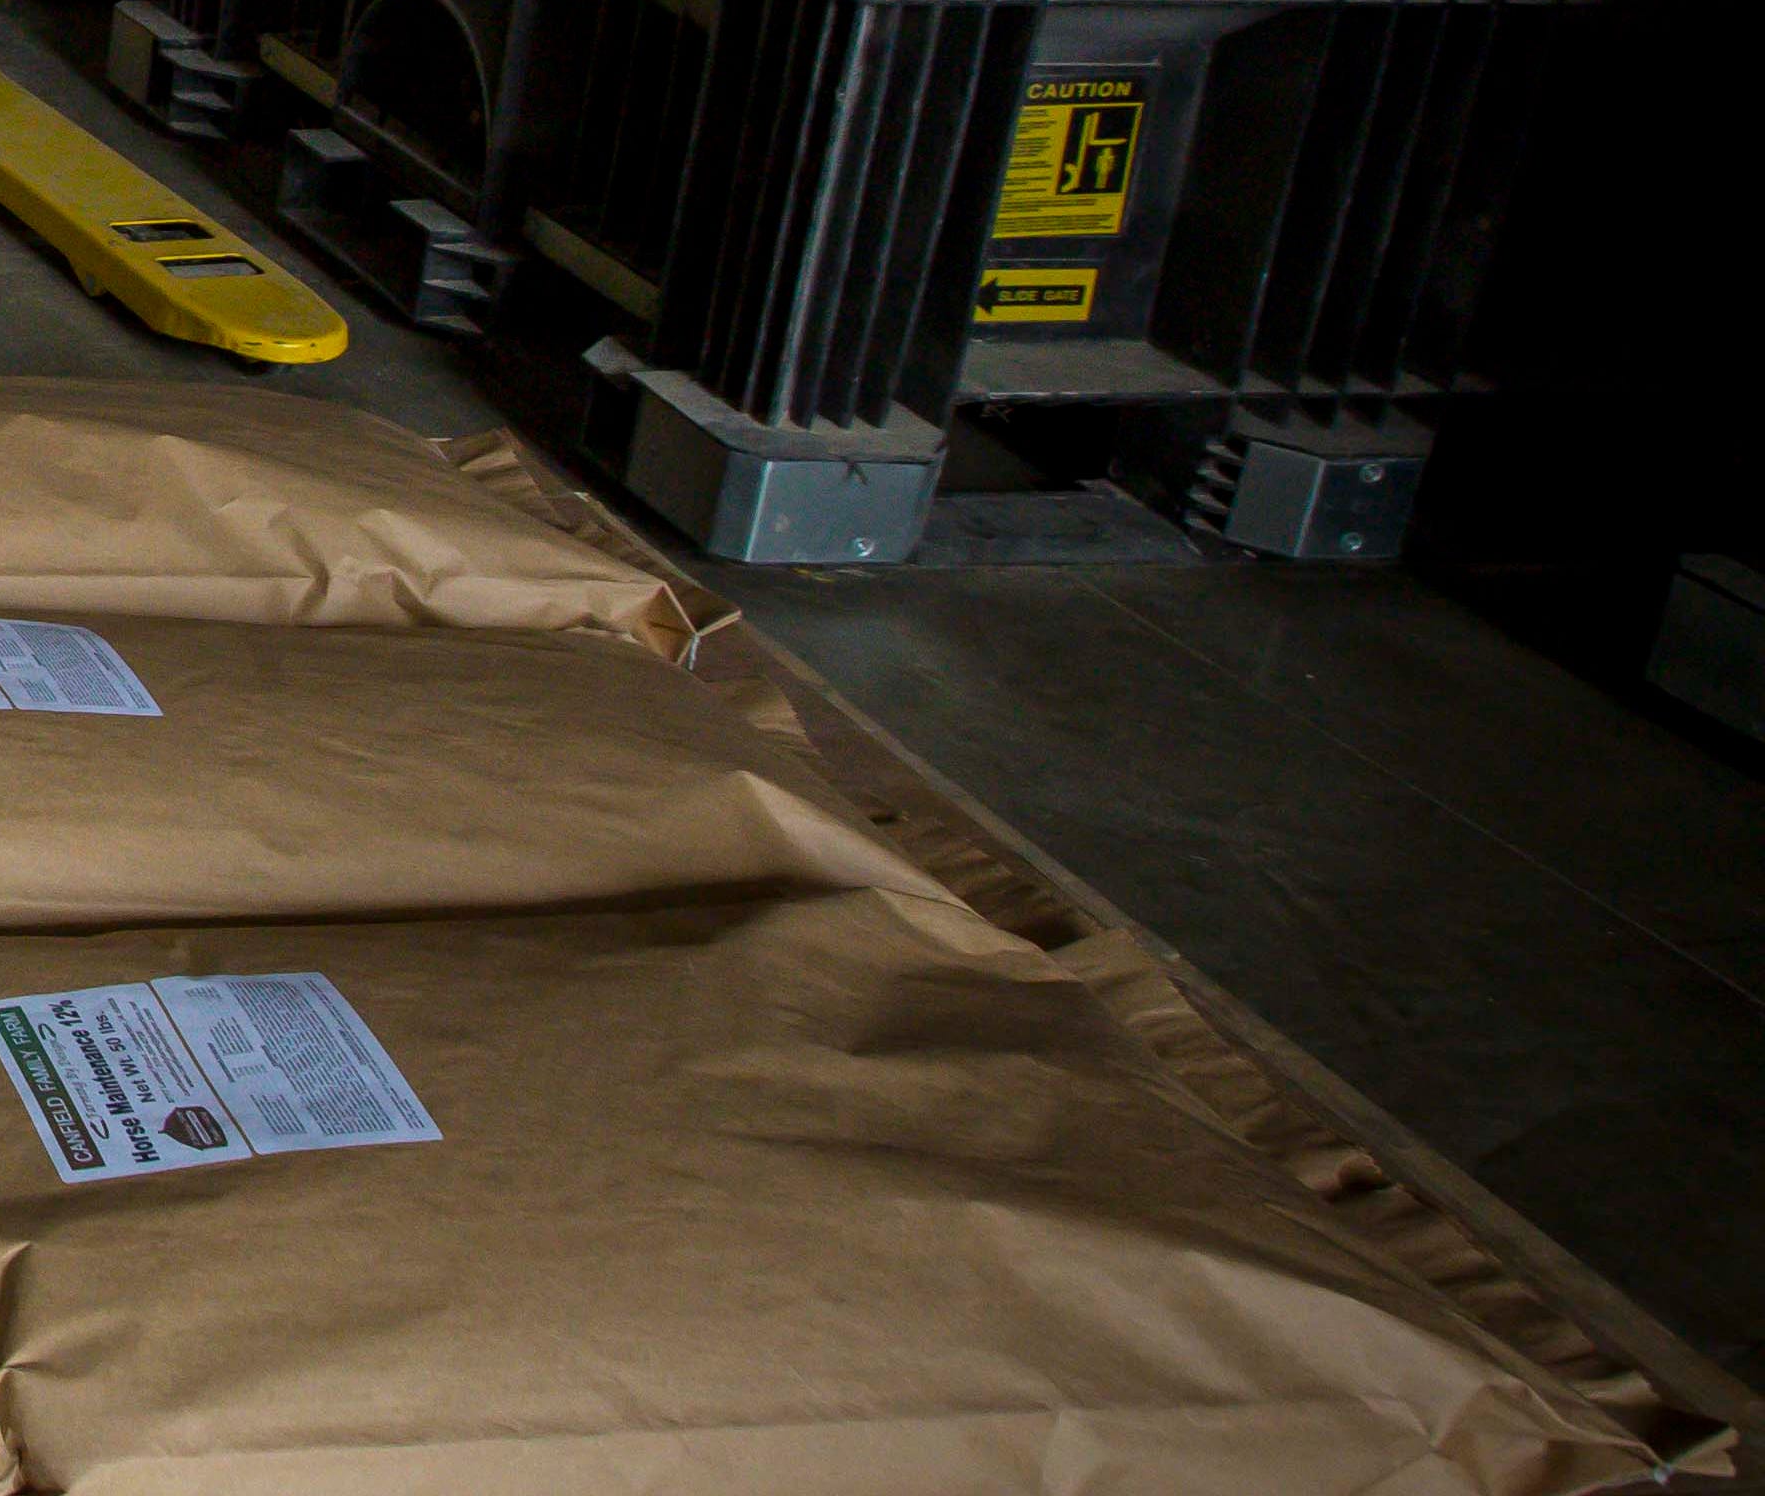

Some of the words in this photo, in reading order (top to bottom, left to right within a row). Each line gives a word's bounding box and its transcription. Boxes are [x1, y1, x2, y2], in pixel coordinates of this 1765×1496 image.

[1027, 80, 1133, 100] CAUTION
[1043, 288, 1079, 302] GATE
[48, 999, 82, 1027] 12%
[96, 1011, 115, 1034] lbs.
[1, 1012, 31, 1045] FARM
[106, 1037, 126, 1052] 50
[21, 1050, 57, 1092] FAMILY
[72, 1029, 134, 1115] Maintenance
[119, 1054, 141, 1077] Wt.
[135, 1078, 156, 1103] Net
[47, 1097, 93, 1163] CANFIELD
[121, 1117, 161, 1163] Horse
